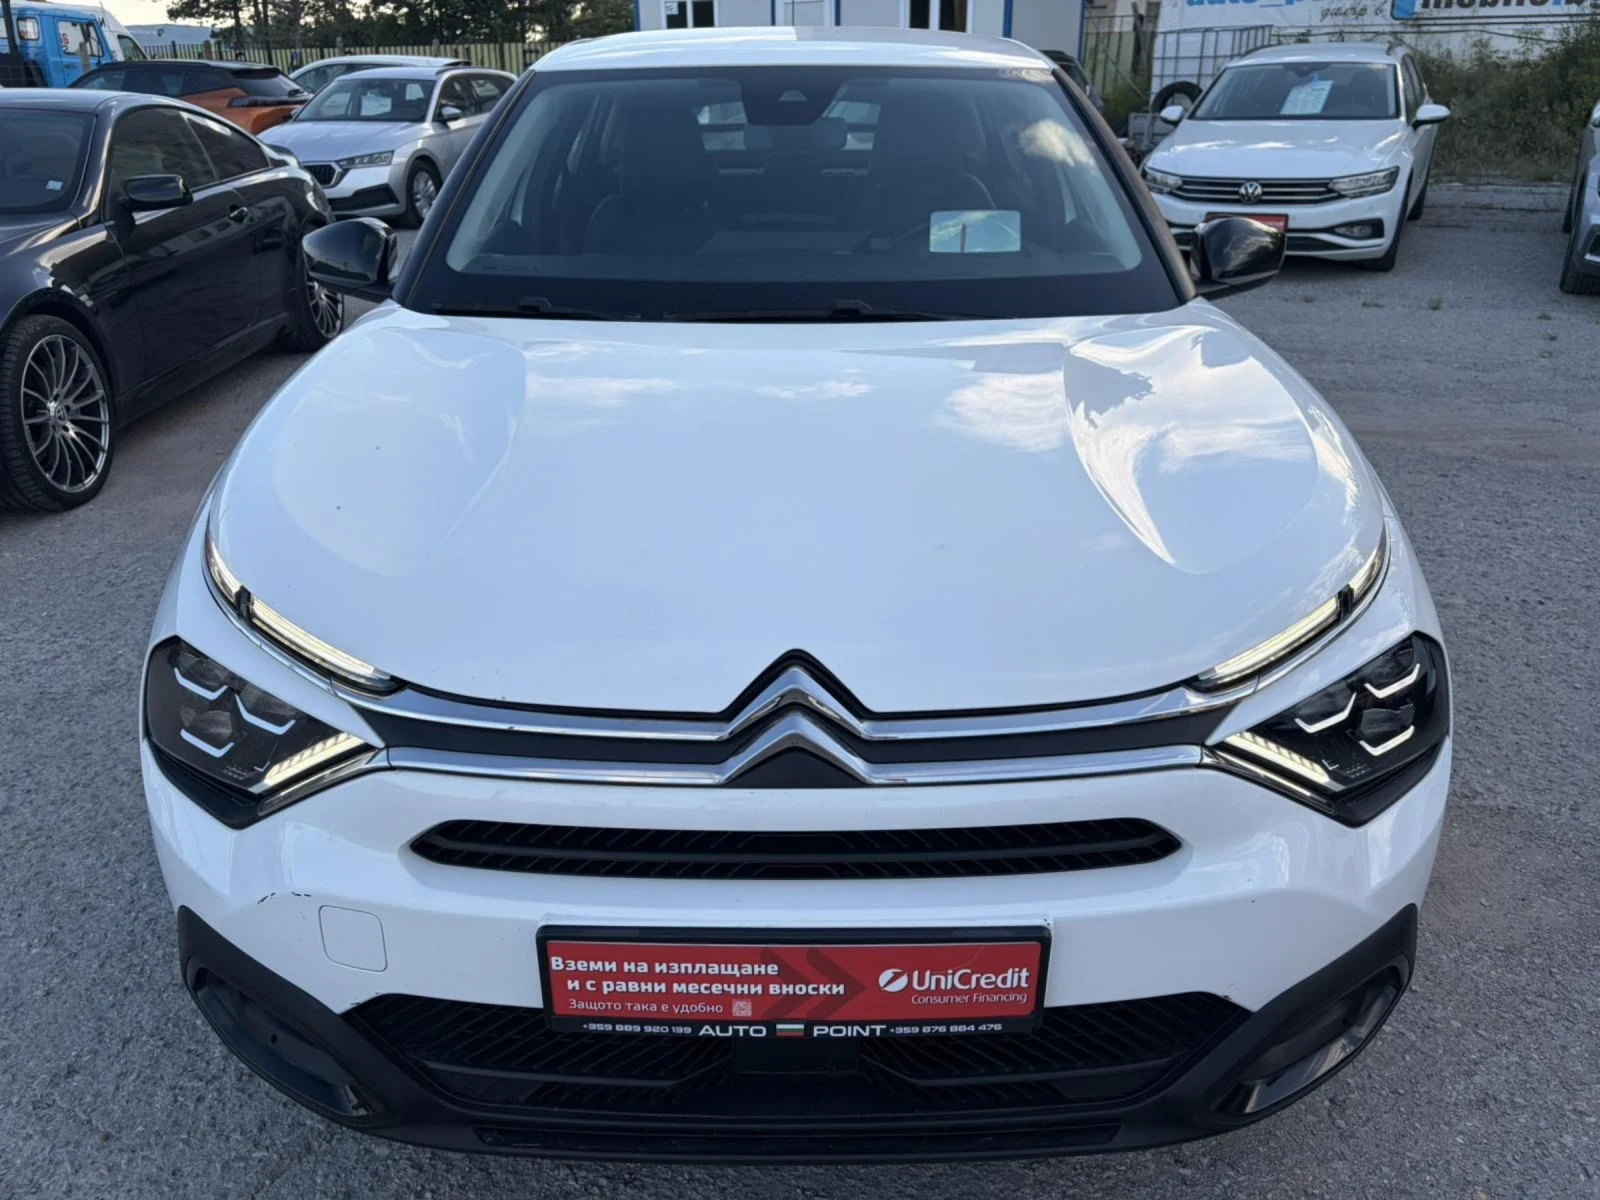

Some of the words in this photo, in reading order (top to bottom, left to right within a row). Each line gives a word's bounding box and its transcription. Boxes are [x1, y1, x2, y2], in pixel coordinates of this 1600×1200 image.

[550, 956, 617, 973] Вземи
[623, 961, 649, 974] на
[654, 962, 779, 978] изплащане
[567, 979, 580, 991] и
[585, 980, 597, 991] с
[602, 980, 666, 995] равни
[672, 982, 763, 995] месечни
[769, 983, 845, 995] вноски
[912, 967, 1030, 991] UniCredit
[911, 993, 969, 1005] Consumer
[972, 991, 1027, 1004] Financing
[568, 998, 622, 1012] Защото
[626, 1001, 658, 1012] така
[661, 1002, 669, 1012] е
[672, 1002, 724, 1015] удобно
[582, 1022, 613, 1031] +359
[643, 1025, 669, 1033] 920
[698, 1024, 767, 1037] AUTO
[813, 1024, 887, 1037] POINT
[889, 1026, 919, 1034] +359
[977, 1023, 1002, 1031] 476
